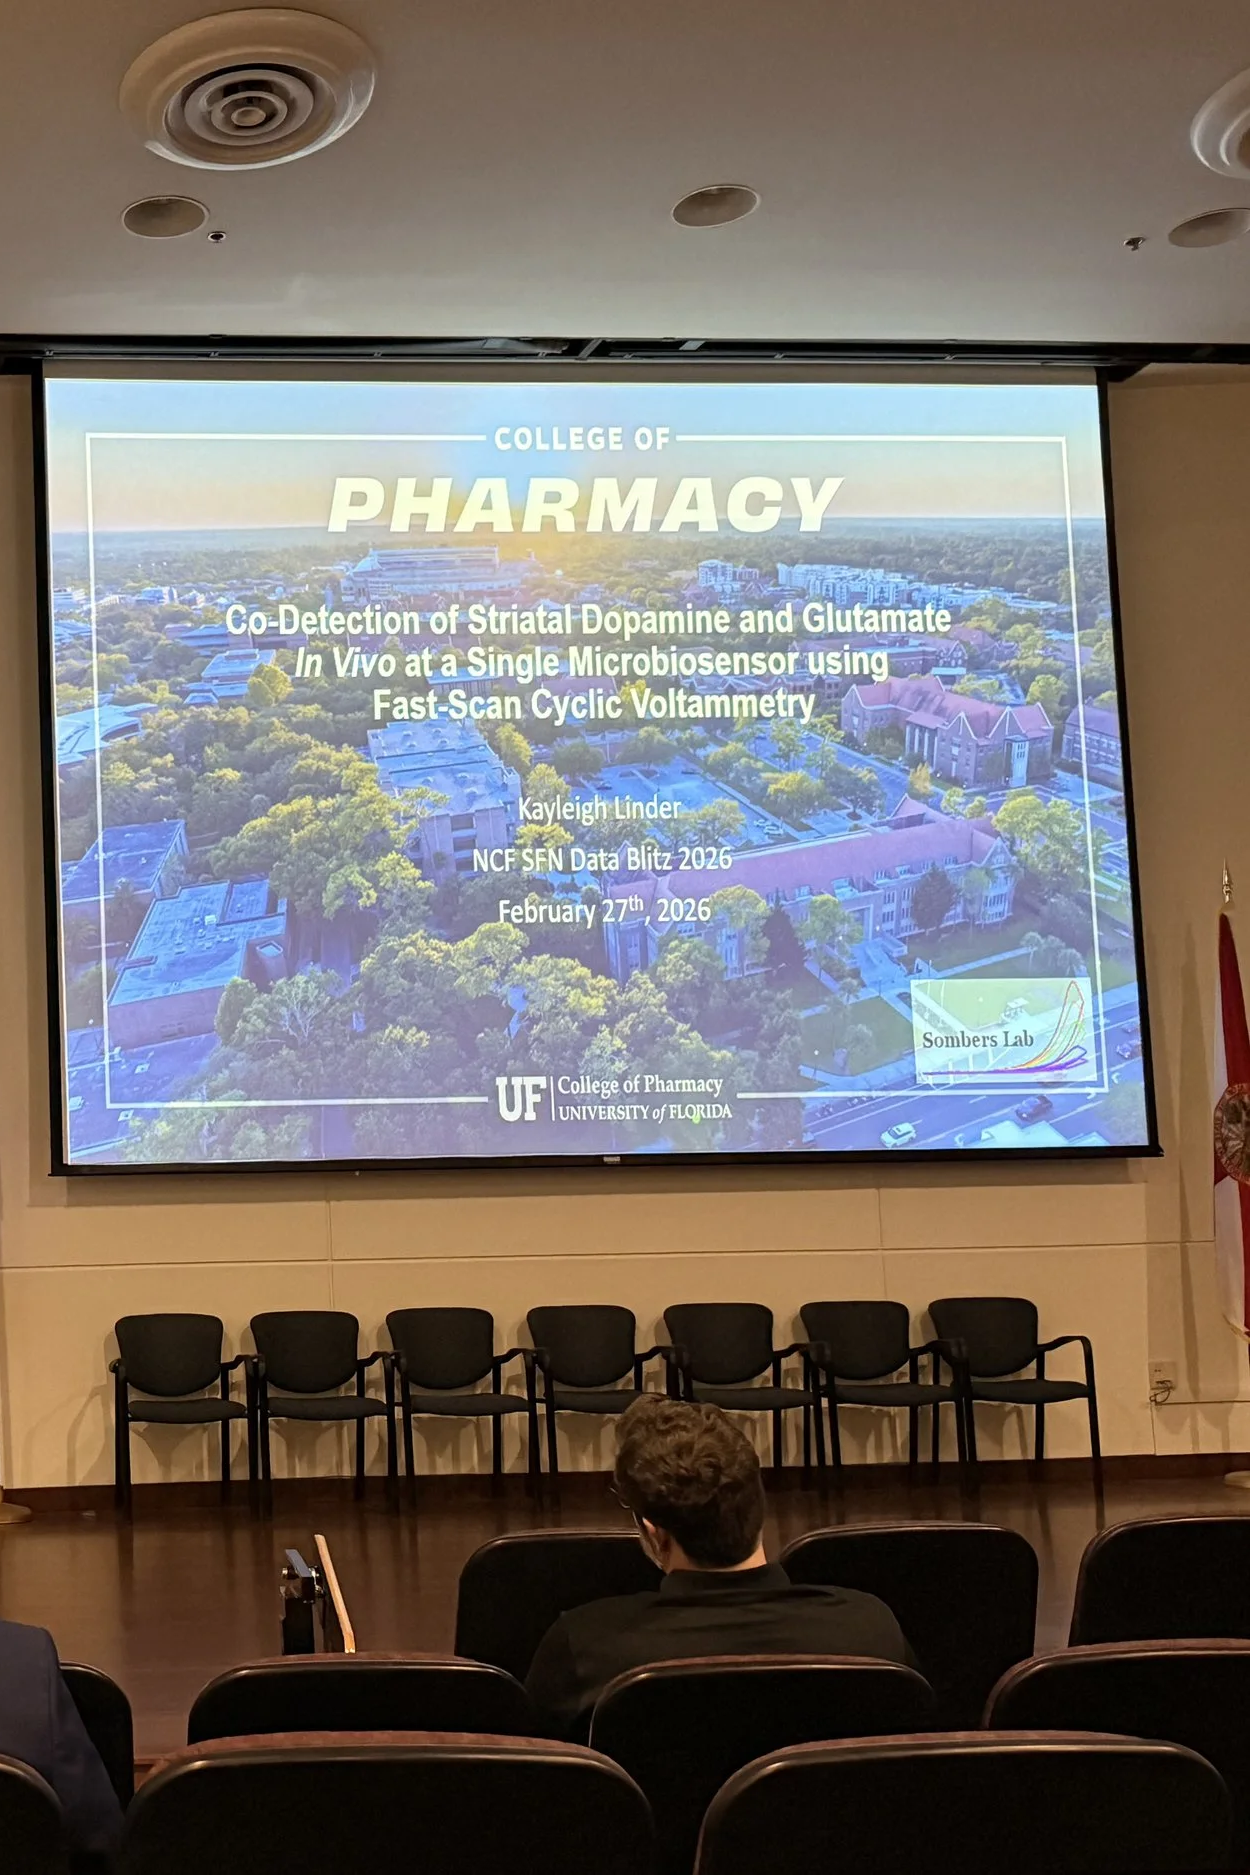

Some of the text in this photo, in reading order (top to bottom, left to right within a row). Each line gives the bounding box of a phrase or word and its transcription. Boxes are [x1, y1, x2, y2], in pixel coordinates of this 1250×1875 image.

[493, 426, 671, 451] COLLEGE OF
[326, 476, 846, 534] PHARMACY
[225, 601, 952, 641] Co-Detection of Striatal Dopamine and Glutamate
[294, 643, 890, 684] In Vivo at a Single Microbiosensor using
[373, 687, 817, 727] Fast-Scan Cyclic Voltammetry
[518, 793, 683, 826] Kayleigh Linder
[472, 846, 733, 872] NCF SFN Data Blitz 2026
[498, 898, 596, 929] February
[656, 898, 711, 922] 2026
[922, 1029, 1034, 1049] Sombers Lab
[495, 1075, 547, 1122] UF
[557, 1074, 724, 1099] College of Pharmacy
[558, 1103, 733, 1124] UNIVERSITY of FLORIDA
